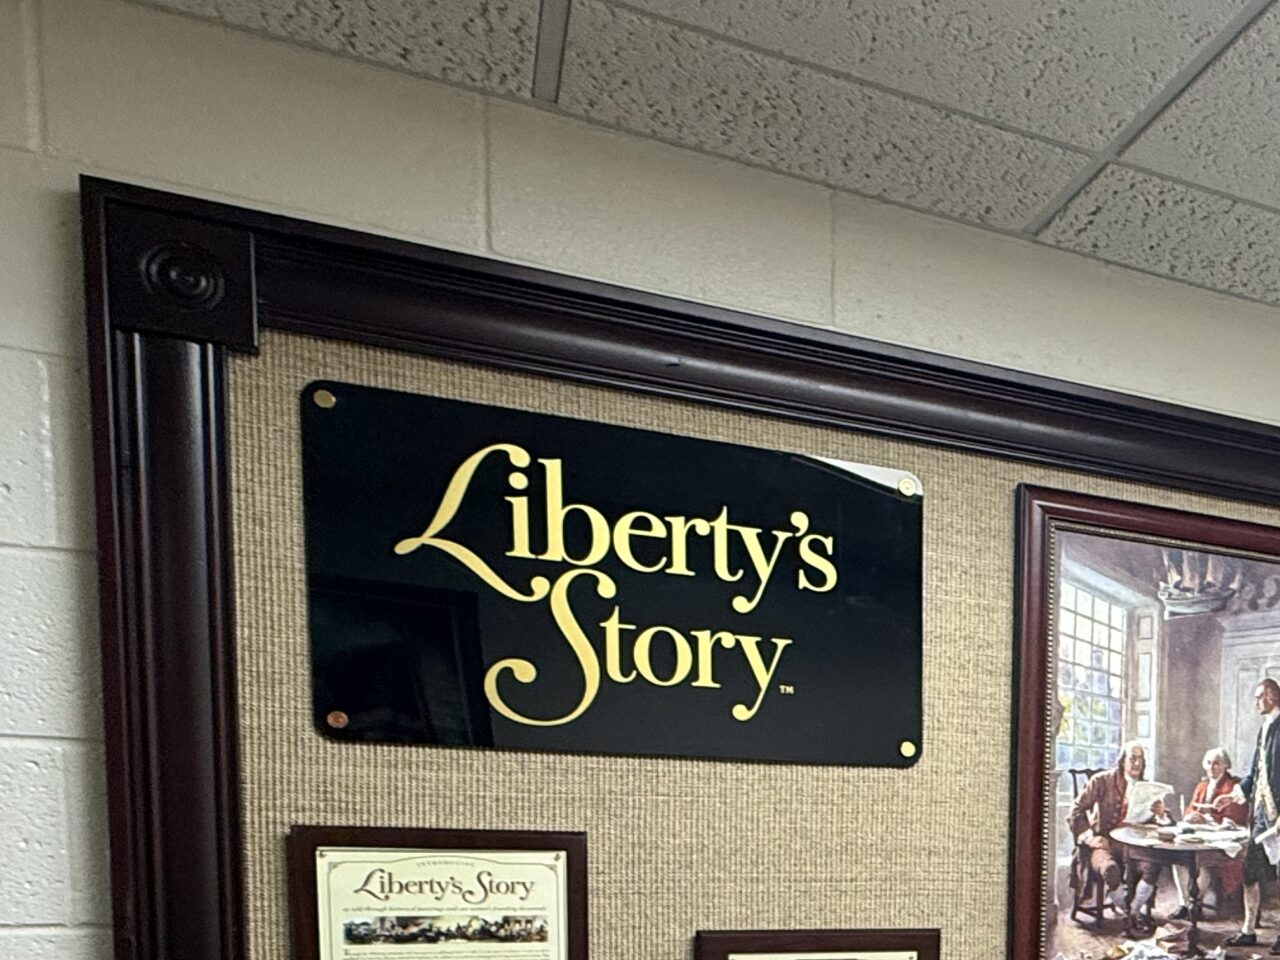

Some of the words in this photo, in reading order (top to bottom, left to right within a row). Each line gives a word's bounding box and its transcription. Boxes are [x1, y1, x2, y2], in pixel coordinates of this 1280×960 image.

[394, 442, 838, 614] Liberty's
[484, 569, 793, 727] Story
[353, 868, 463, 902] Liberty's
[462, 870, 536, 905] Story
